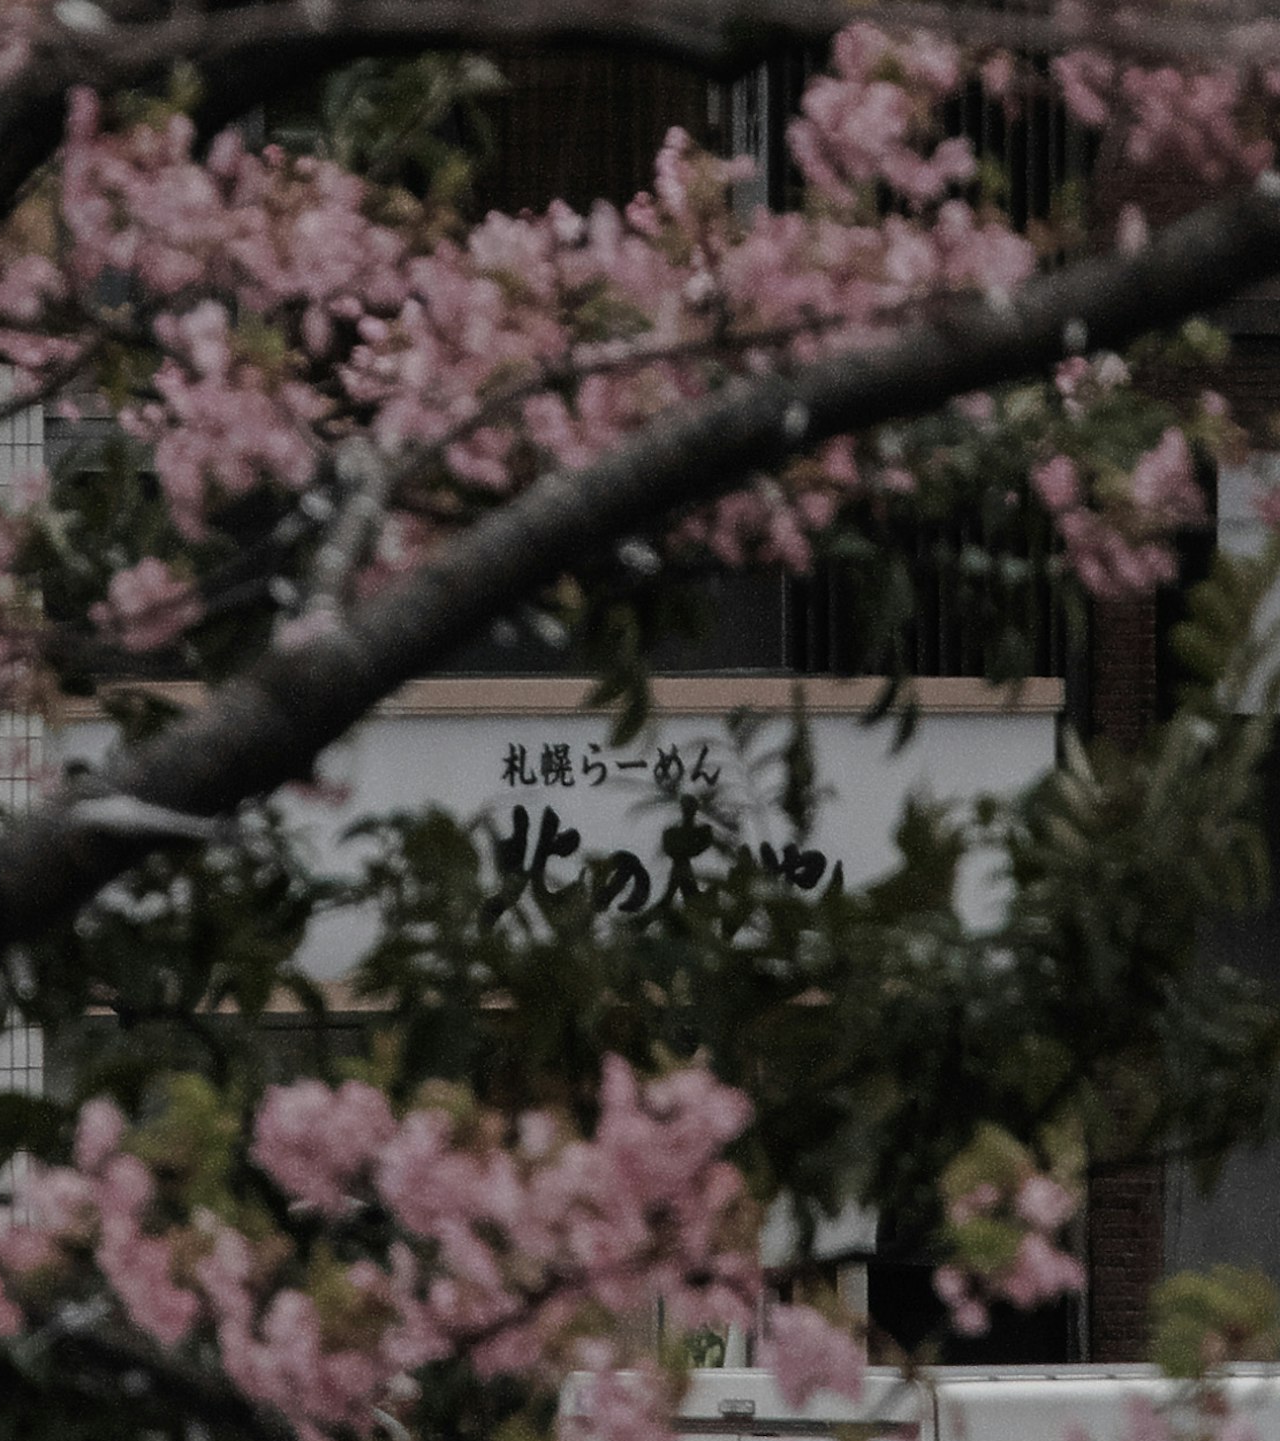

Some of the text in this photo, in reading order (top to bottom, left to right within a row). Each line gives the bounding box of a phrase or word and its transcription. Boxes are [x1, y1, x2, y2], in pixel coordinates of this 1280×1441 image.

[501, 743, 722, 787] 札幌らーめん
